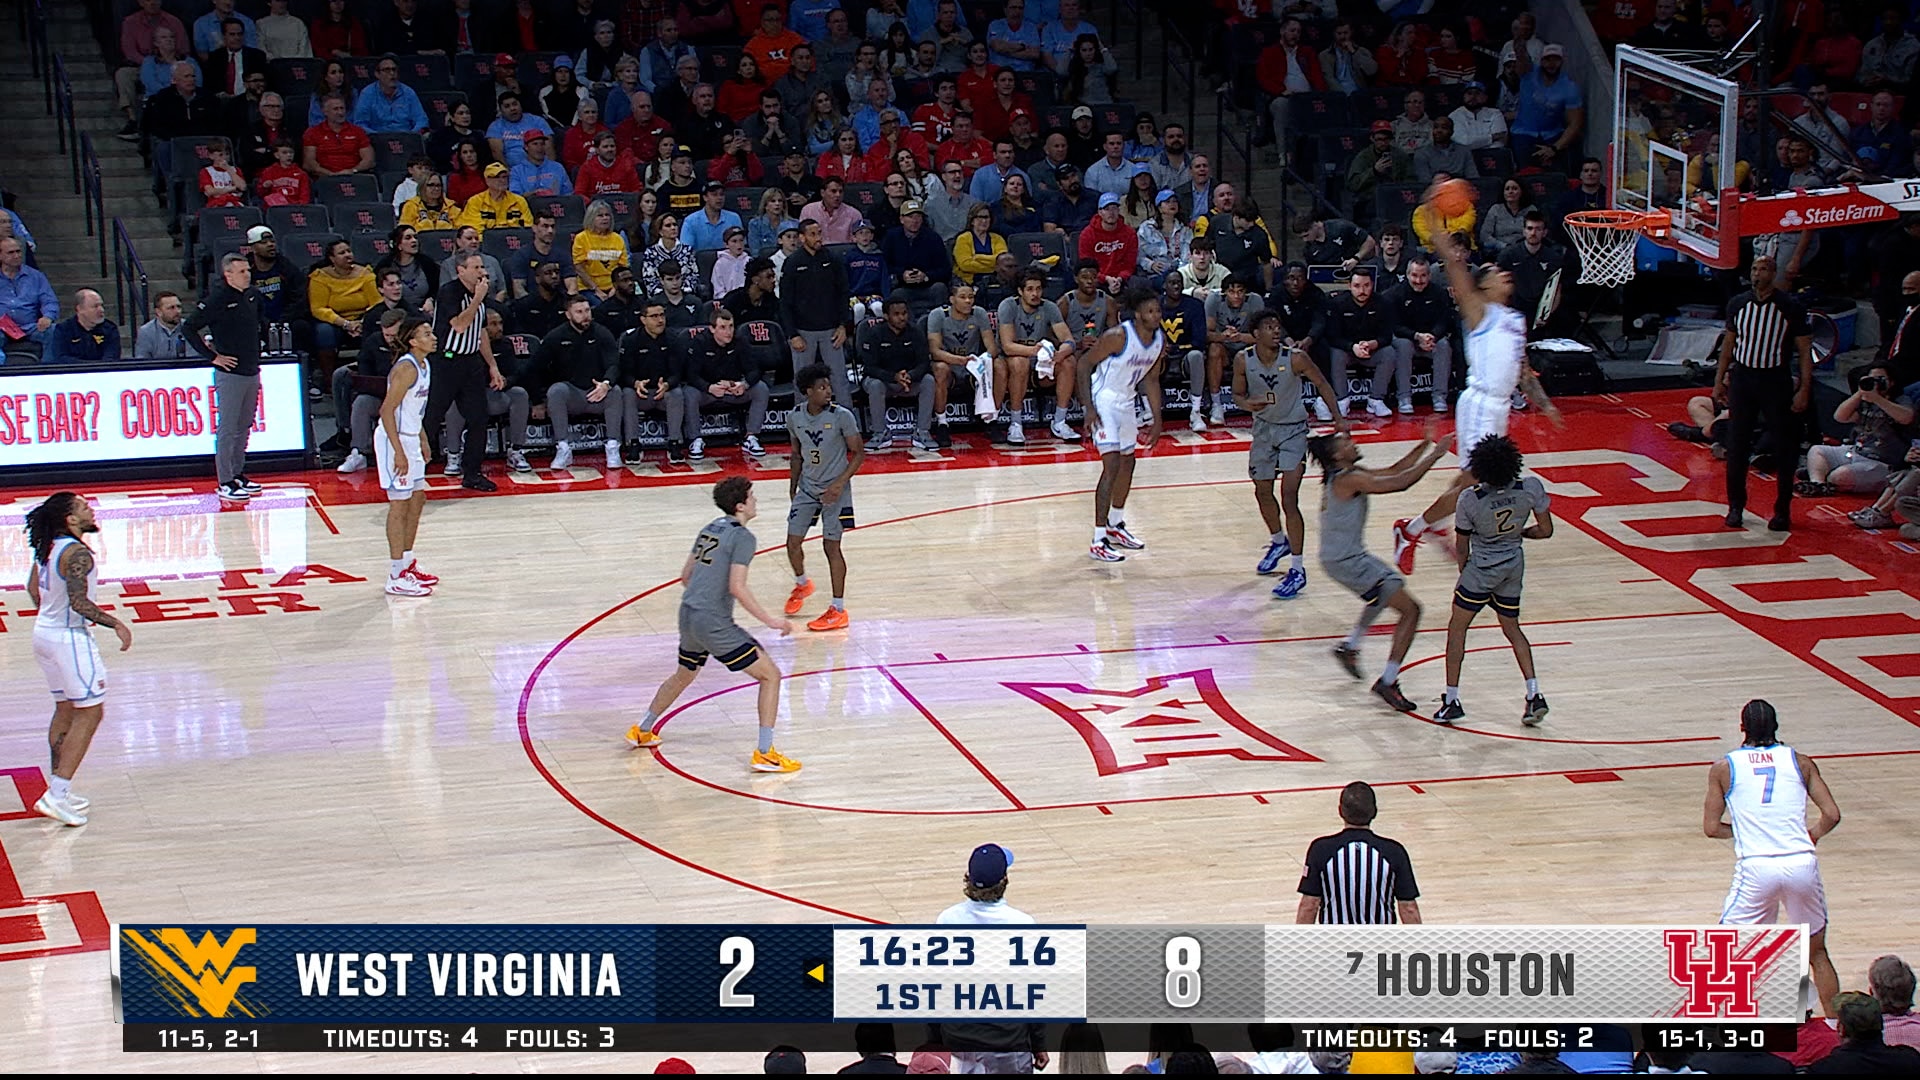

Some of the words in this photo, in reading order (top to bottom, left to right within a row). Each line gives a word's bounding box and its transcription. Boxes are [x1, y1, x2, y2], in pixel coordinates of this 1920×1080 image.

[35, 392, 101, 444] BAR?
[120, 386, 204, 440] COOGS
[810, 450, 822, 466] 3
[1494, 508, 1516, 534] 2
[694, 534, 720, 566] 52
[1748, 753, 1774, 764] UZAN
[1753, 766, 1776, 804] 7
